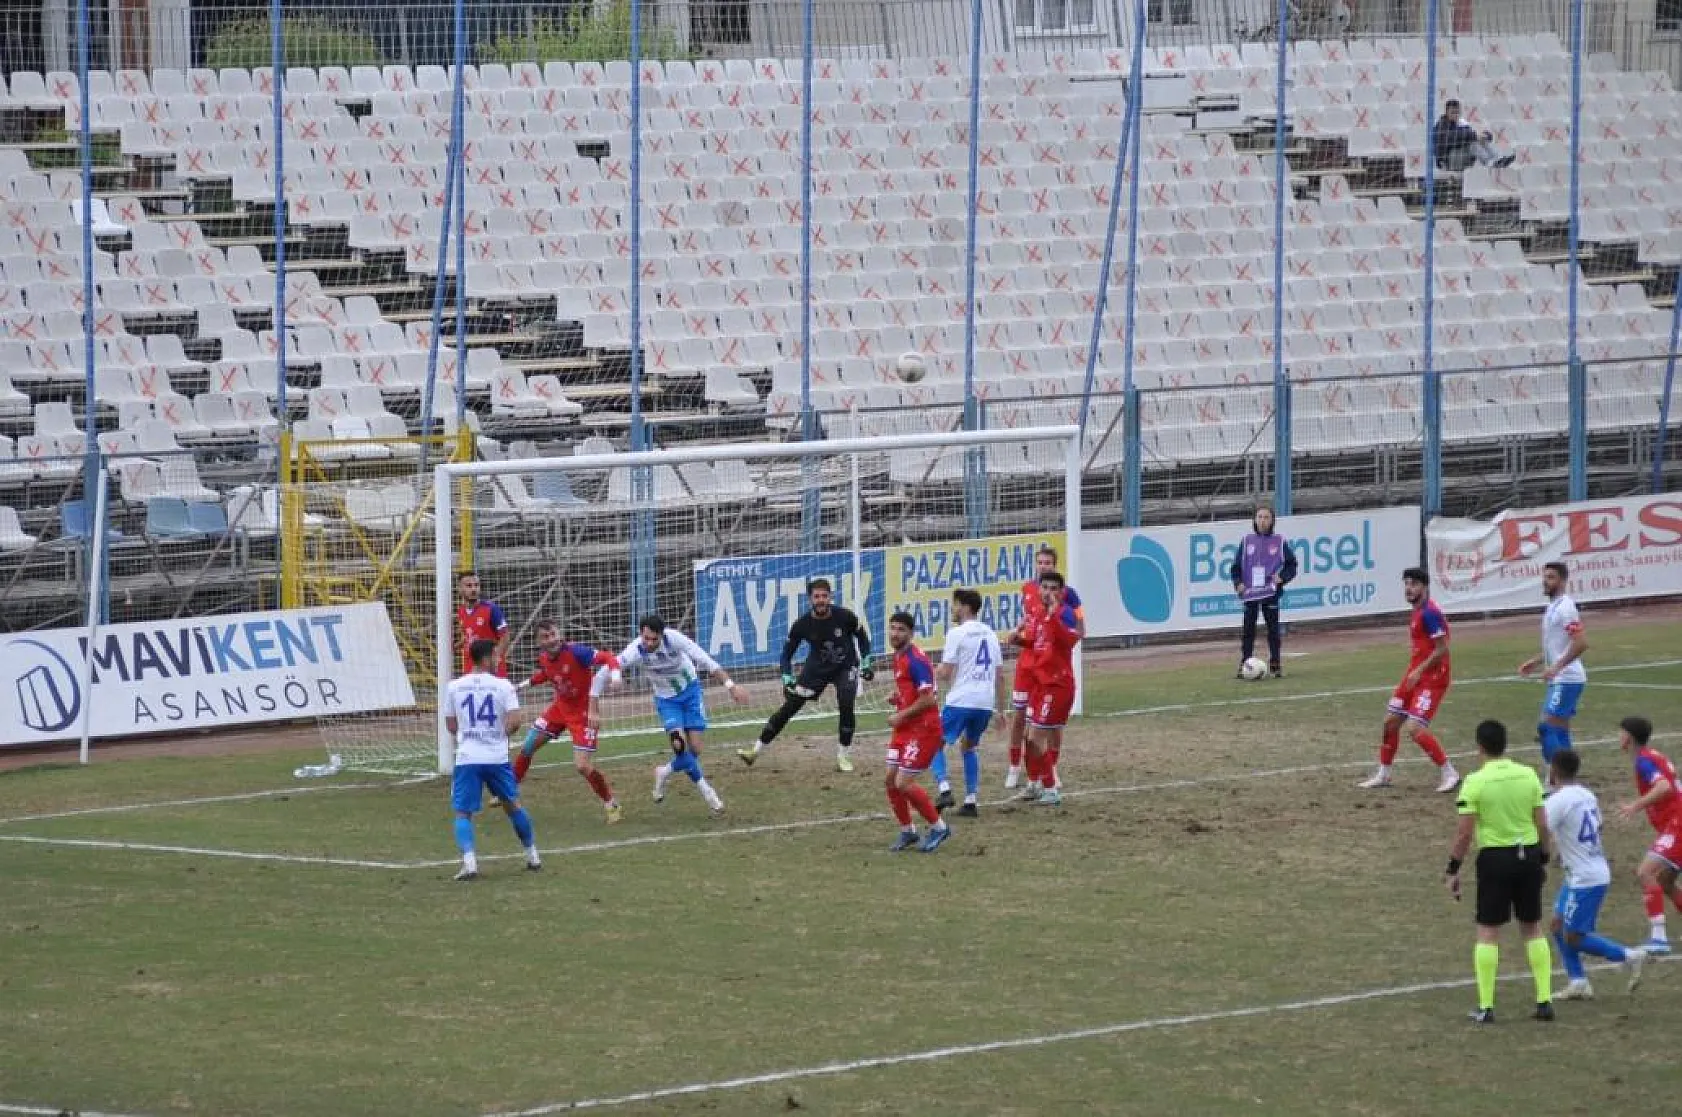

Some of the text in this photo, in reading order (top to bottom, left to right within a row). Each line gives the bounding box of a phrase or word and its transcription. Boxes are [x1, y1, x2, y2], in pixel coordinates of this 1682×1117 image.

[1492, 502, 1682, 563] FES
[901, 542, 1049, 593] PAZARLAM
[710, 571, 873, 655] AYTK
[1328, 583, 1376, 606] GRUP
[895, 599, 949, 638] API
[975, 638, 993, 672] 4
[134, 674, 343, 724] ASANSÖR
[461, 693, 498, 728] 14
